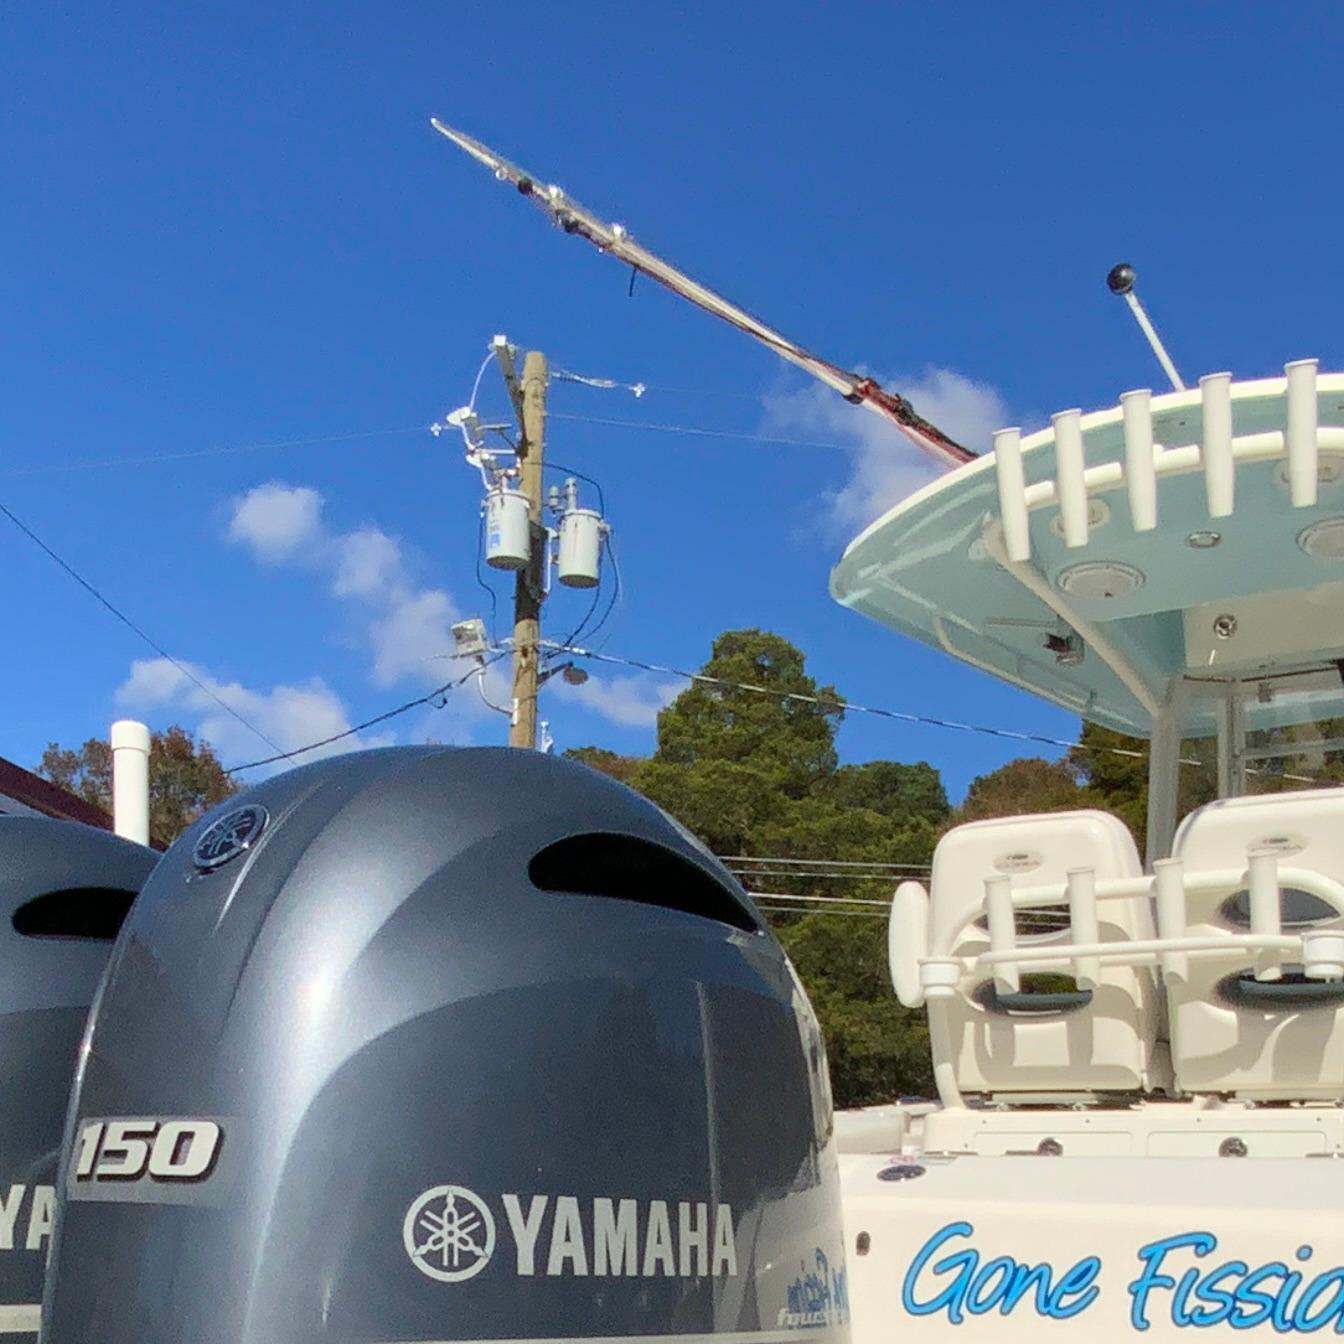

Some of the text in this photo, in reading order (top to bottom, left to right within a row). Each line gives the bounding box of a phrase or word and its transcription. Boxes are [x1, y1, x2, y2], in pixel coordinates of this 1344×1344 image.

[76, 1120, 222, 1180] 150
[502, 1193, 738, 1277] YAMAHA
[902, 1221, 1101, 1325] Gone
